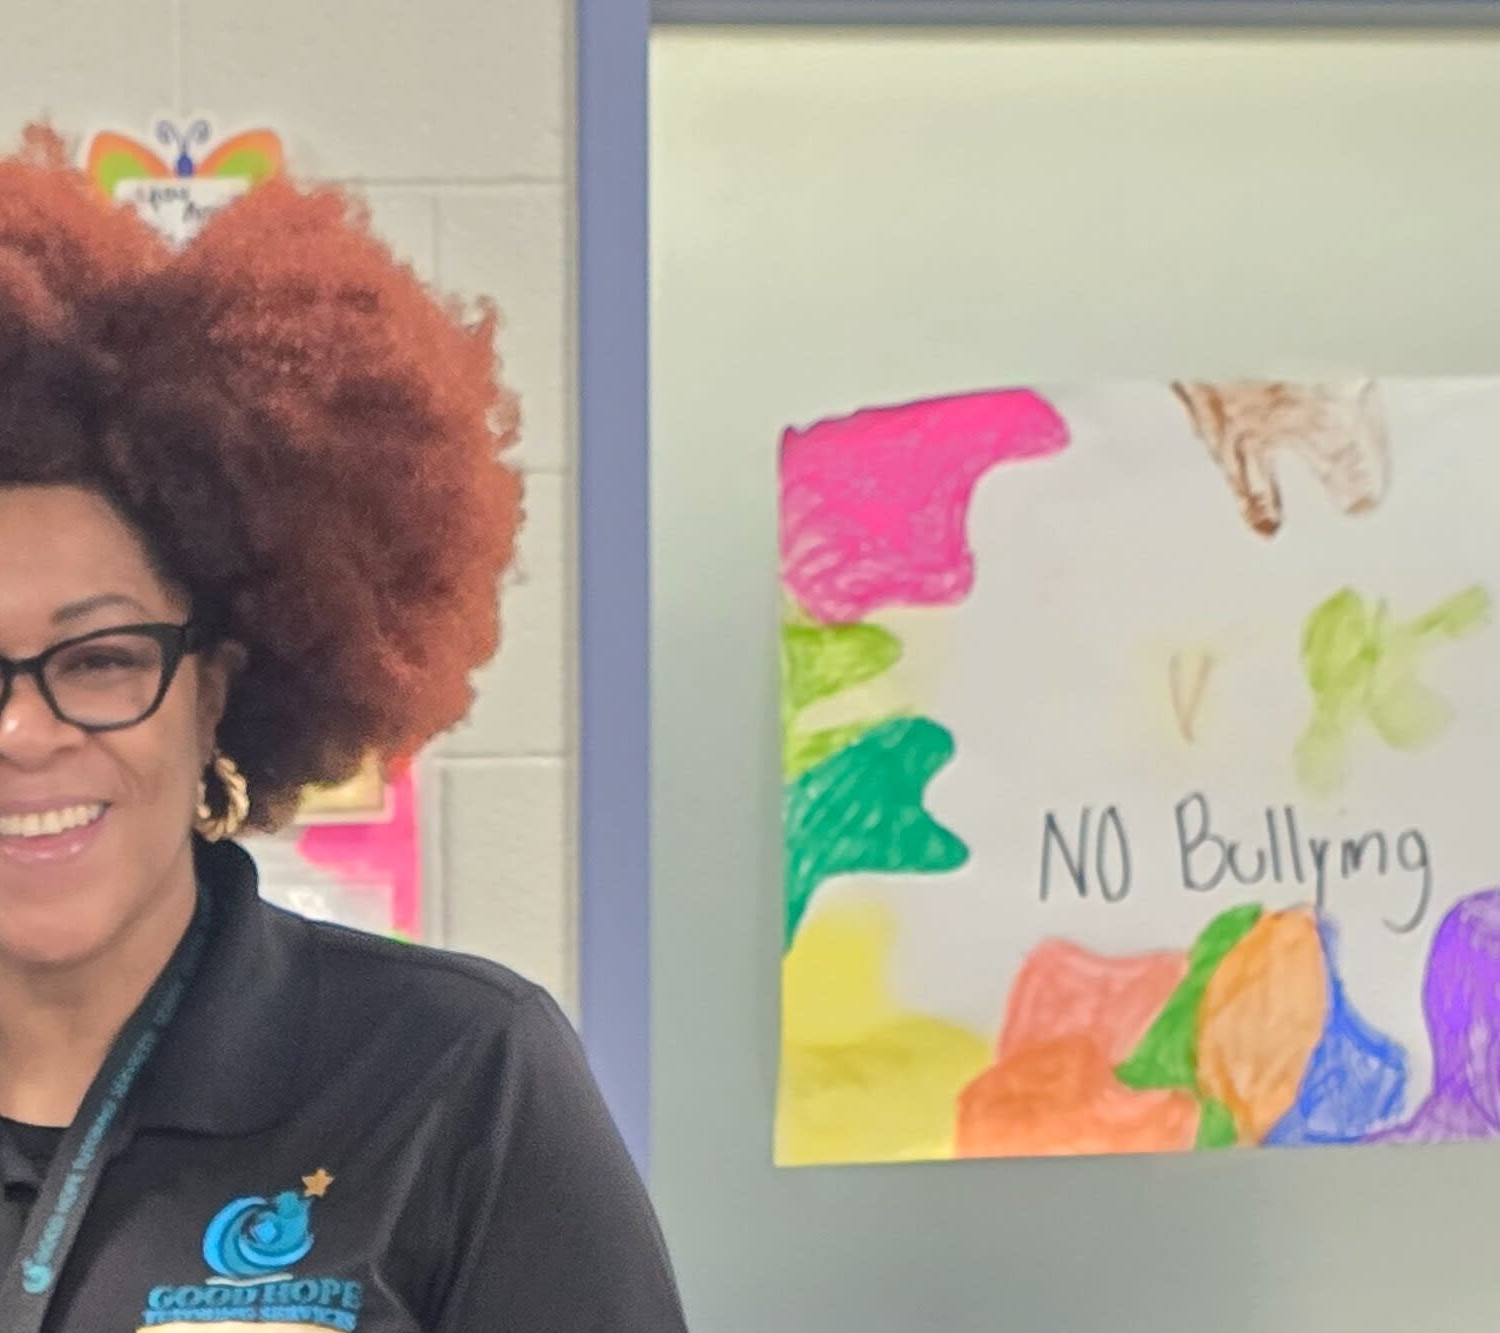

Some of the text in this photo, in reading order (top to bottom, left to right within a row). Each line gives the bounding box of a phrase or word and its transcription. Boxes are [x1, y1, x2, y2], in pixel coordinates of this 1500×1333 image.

[1038, 790, 1432, 934] NO Bullying
[147, 1276, 364, 1310] GOOD HOPE
